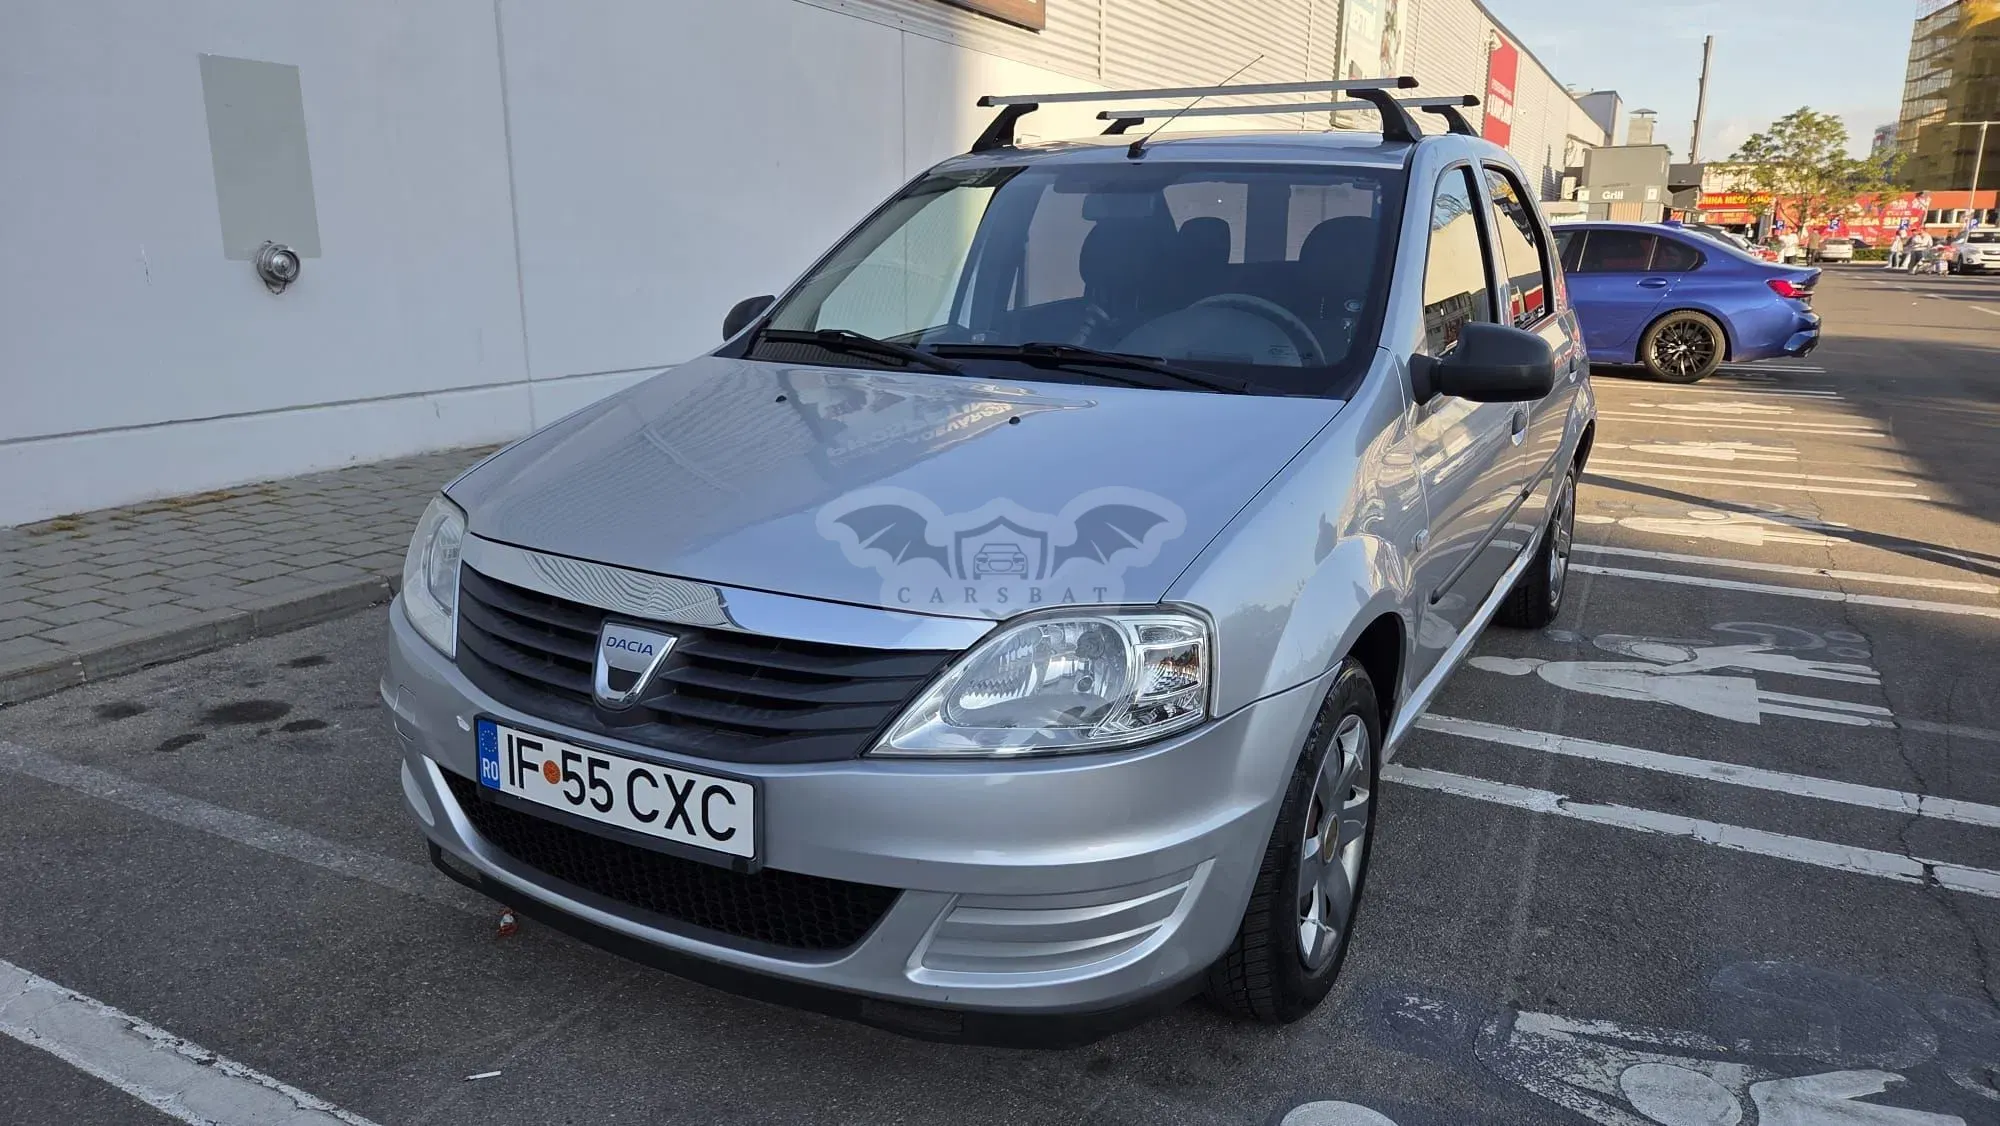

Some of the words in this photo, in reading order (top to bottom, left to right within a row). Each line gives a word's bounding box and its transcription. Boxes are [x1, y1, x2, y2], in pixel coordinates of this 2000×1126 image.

[1602, 190, 1624, 200] Grill
[1883, 216, 1920, 226] SHP
[606, 636, 654, 656] DACIA
[482, 757, 499, 781] RO
[507, 733, 543, 789] IF
[561, 749, 614, 813] 55
[626, 768, 737, 842] CXC
